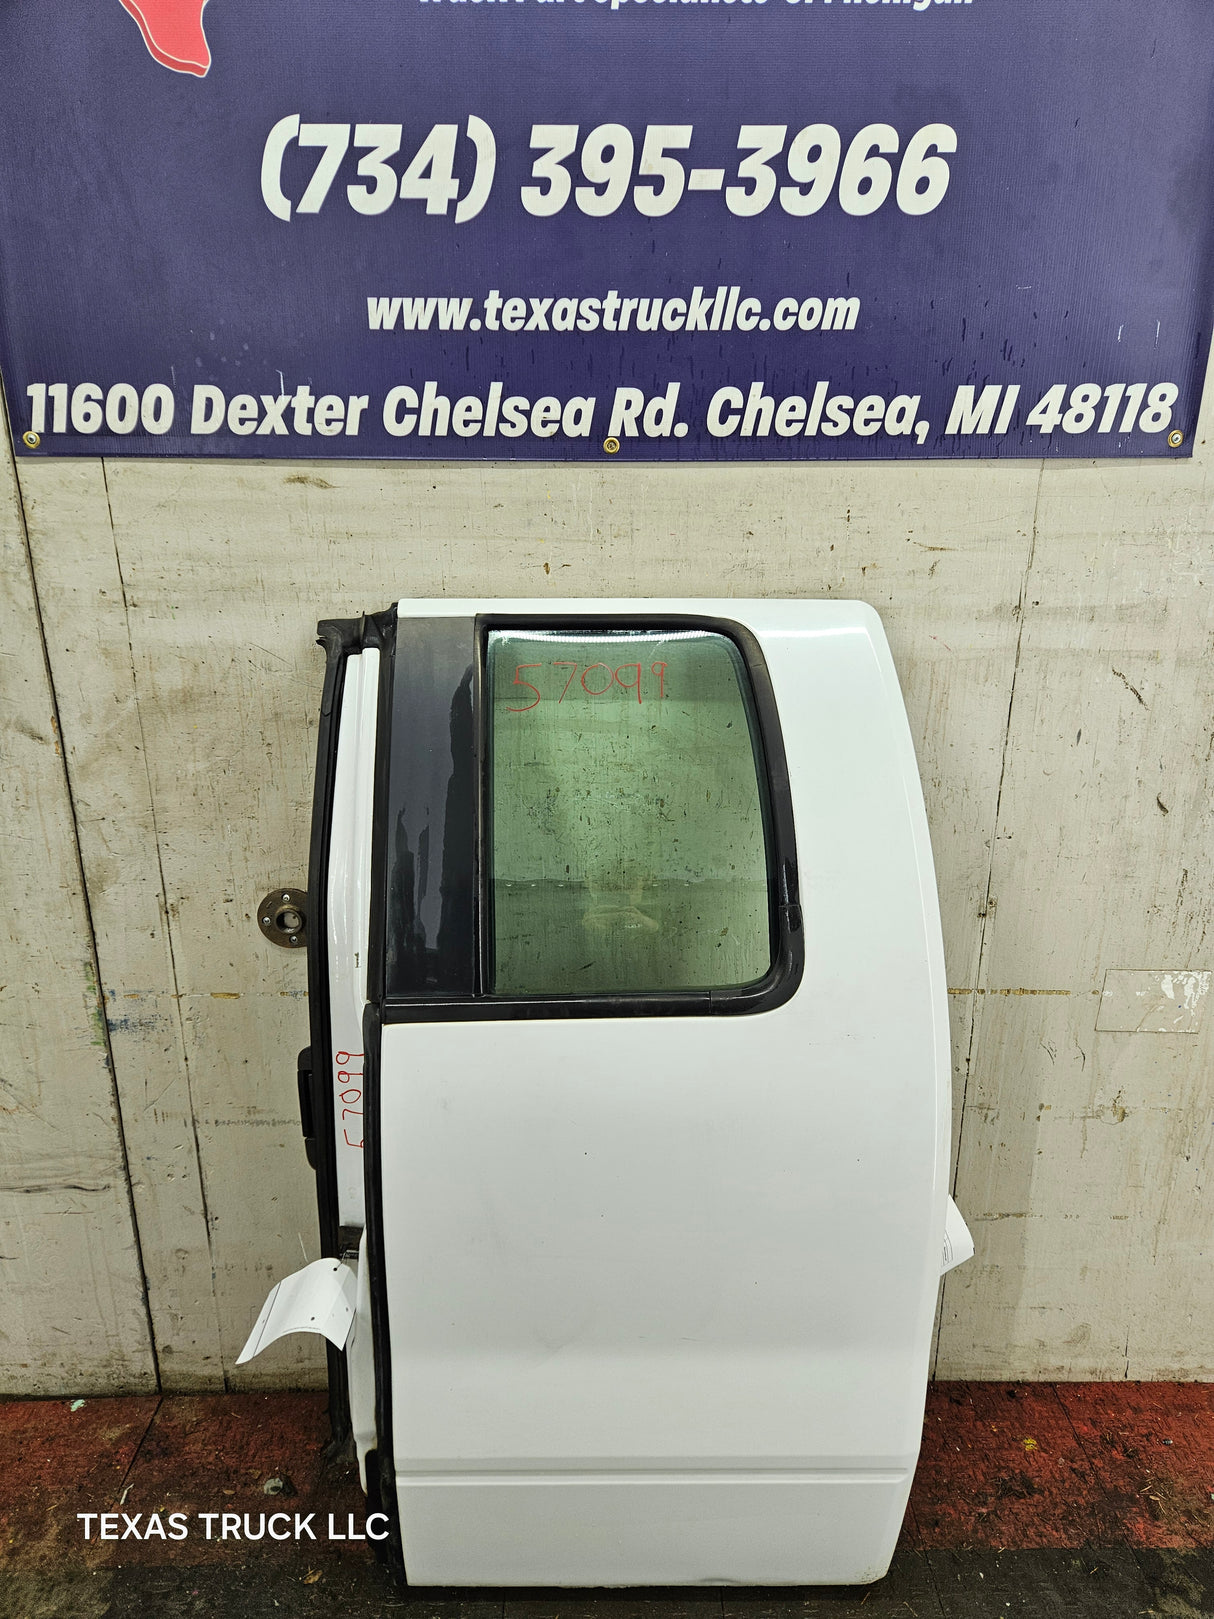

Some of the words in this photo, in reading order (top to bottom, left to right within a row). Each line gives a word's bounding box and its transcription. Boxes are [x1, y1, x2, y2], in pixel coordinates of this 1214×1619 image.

[261, 114, 496, 223] (734)
[521, 124, 957, 216] 395-3966
[367, 286, 860, 331] www.texastruckllc.com
[26, 383, 174, 434] 11600
[191, 385, 369, 436] Dexter
[383, 382, 596, 437] Chelsea
[608, 382, 688, 437] Rd.
[707, 382, 929, 444] Chelsea,
[945, 385, 1020, 434] MI
[1026, 383, 1178, 433] 48118
[505, 661, 668, 712] 57099
